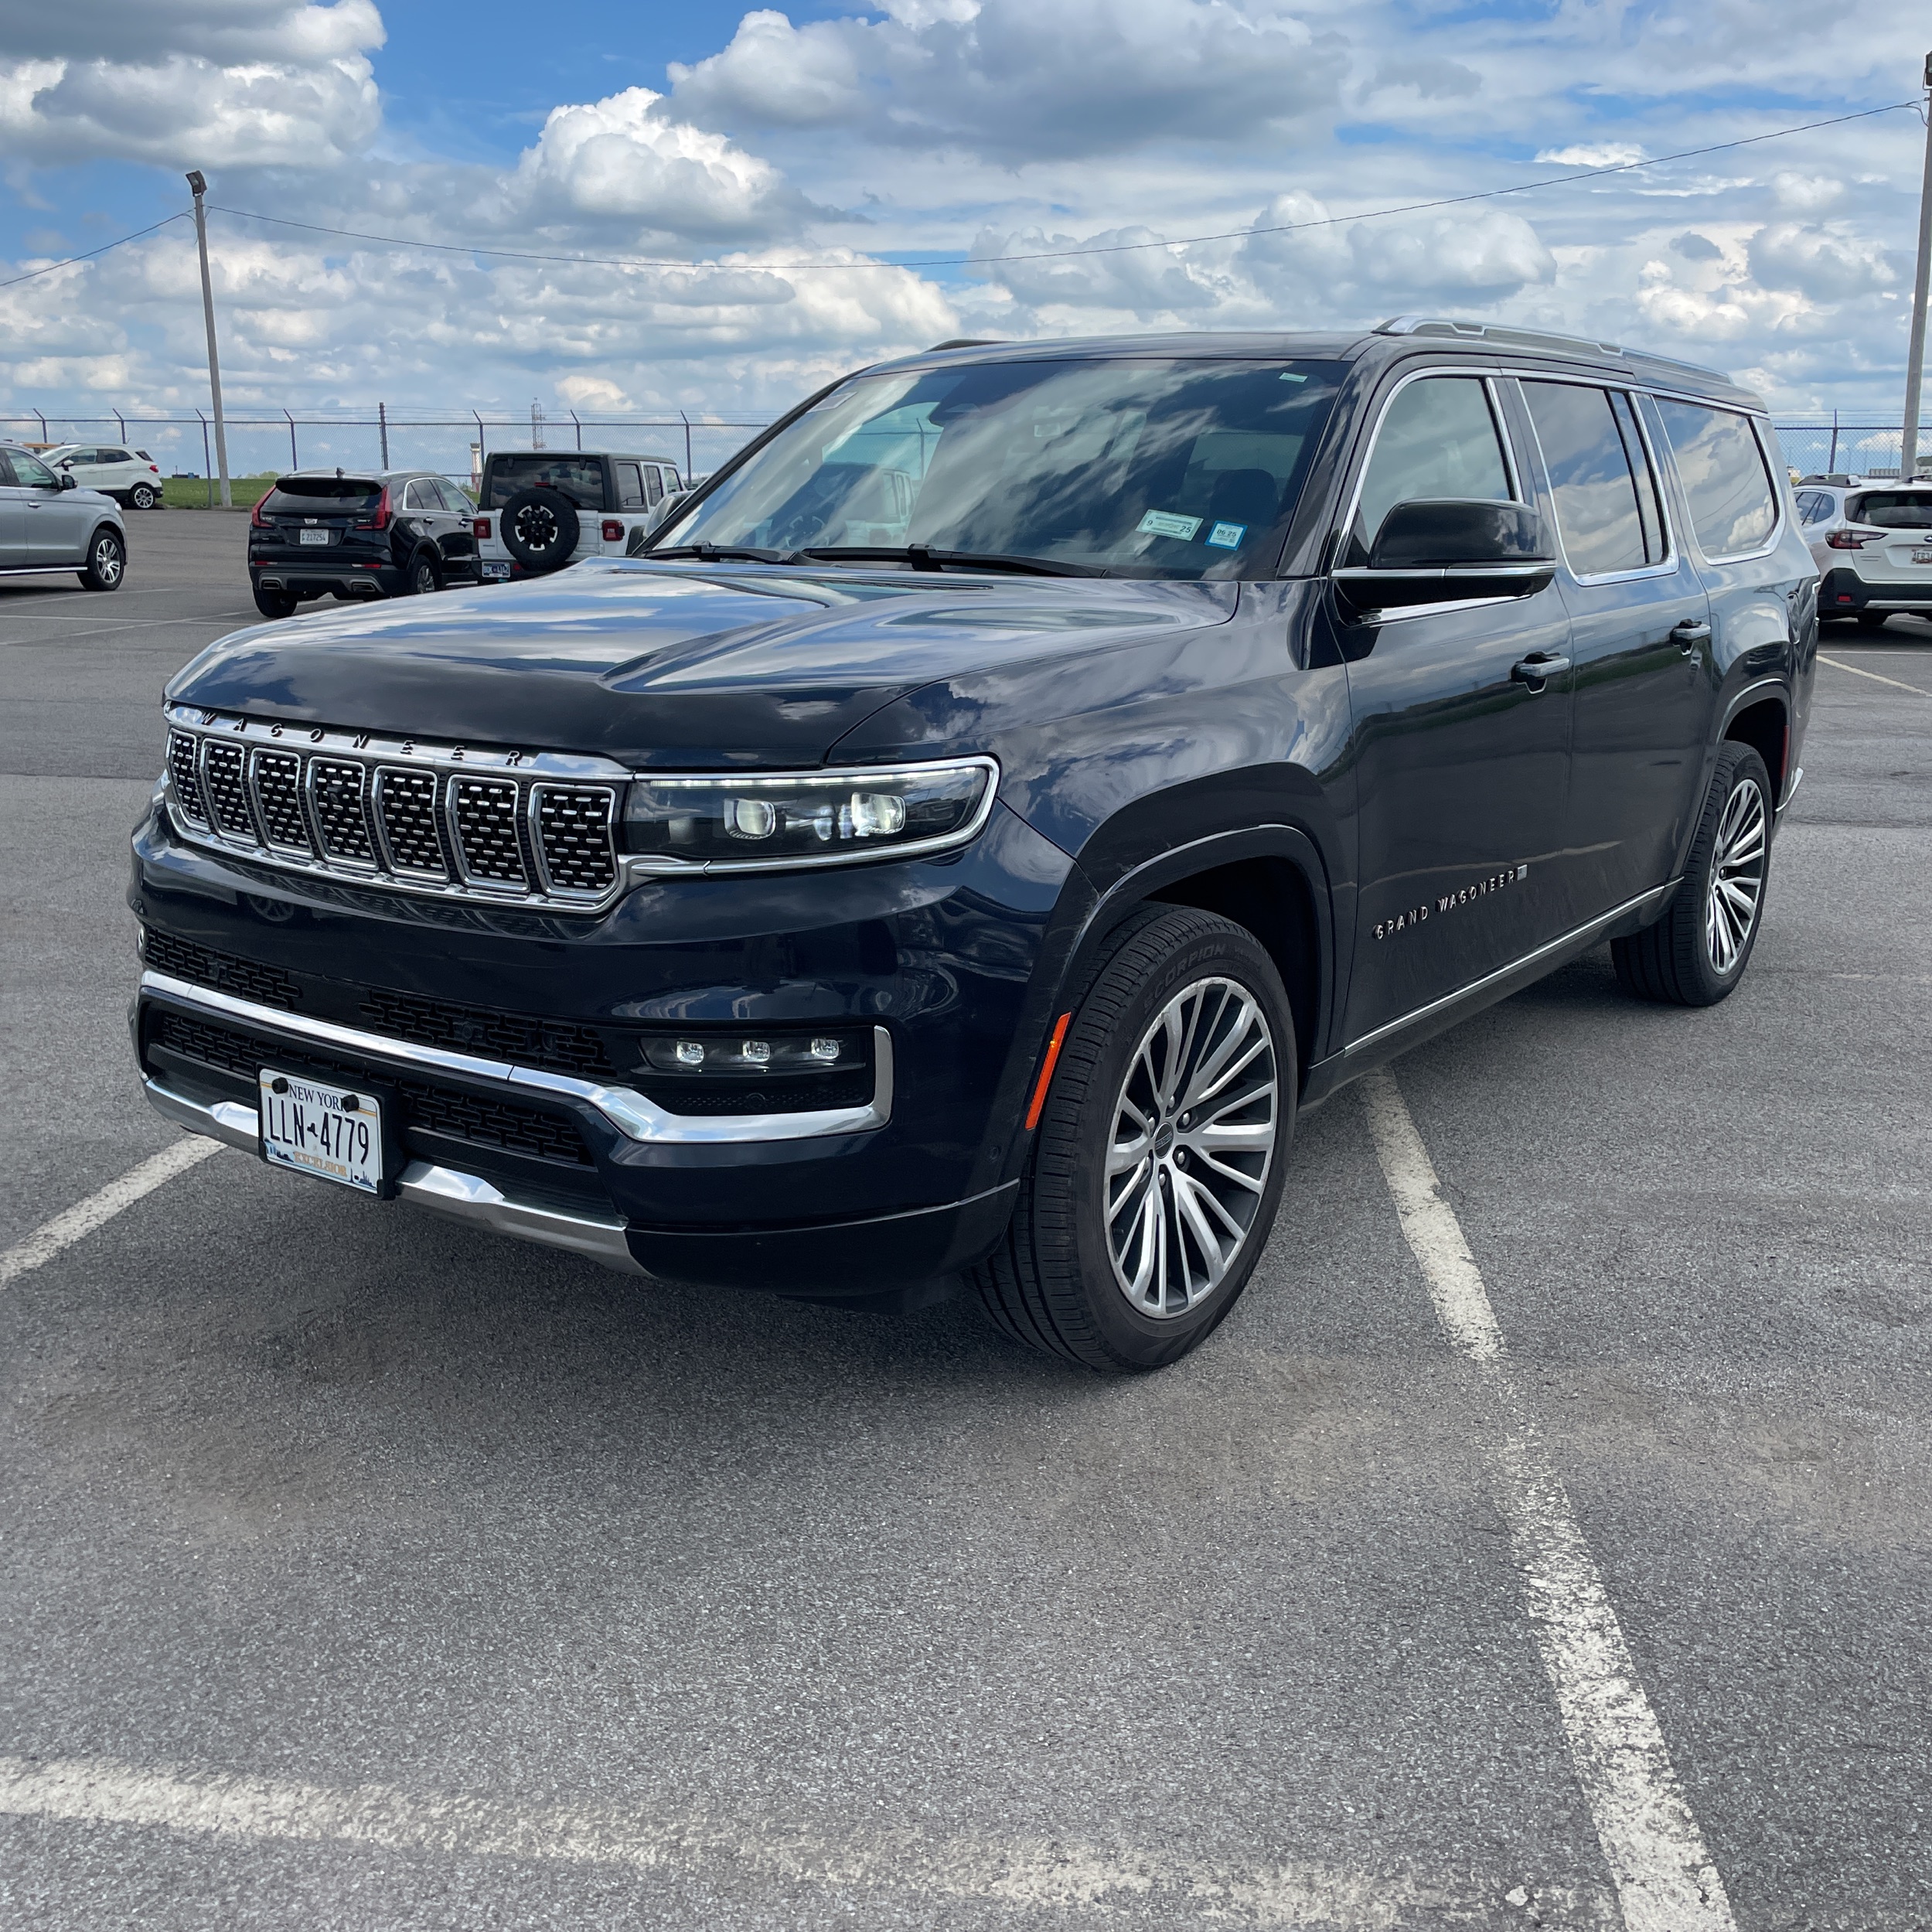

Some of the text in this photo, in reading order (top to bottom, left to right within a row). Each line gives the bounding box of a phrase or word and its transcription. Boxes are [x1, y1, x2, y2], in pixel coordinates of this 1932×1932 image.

[201, 712, 523, 766] WAGONEER
[1373, 870, 1515, 940] GRAND WAGONEER
[1144, 943, 1226, 1014] SCORPION
[288, 1084, 314, 1103] NEW
